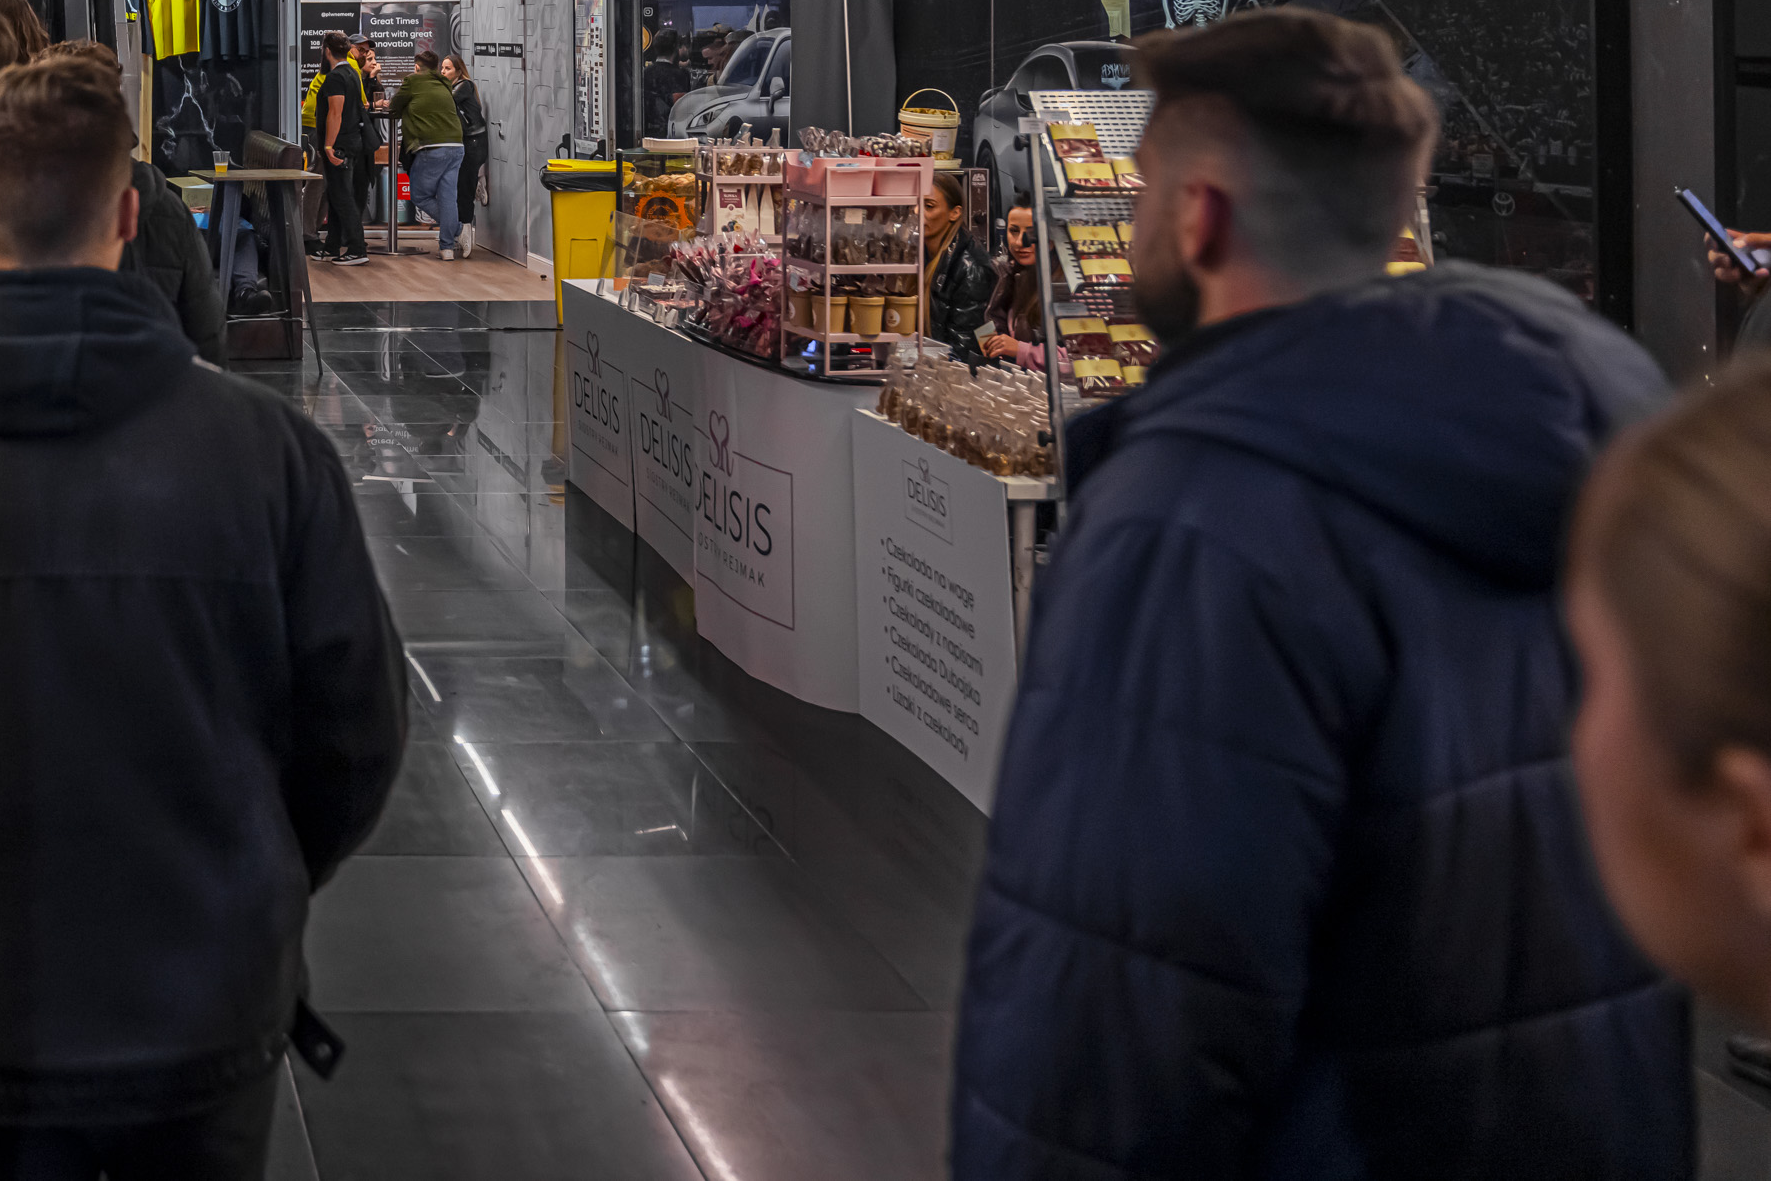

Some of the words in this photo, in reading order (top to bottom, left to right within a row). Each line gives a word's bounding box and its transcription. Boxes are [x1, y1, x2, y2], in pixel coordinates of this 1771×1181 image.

[370, 17, 394, 25] Great
[395, 17, 420, 25] Times
[374, 40, 414, 48] nnovation
[392, 30, 409, 38] with
[410, 30, 433, 40] great
[573, 370, 621, 435] DELISIS
[640, 411, 694, 488] DELISIS
[906, 477, 947, 518] DELISIS
[722, 554, 766, 588] REJMAK
[886, 537, 933, 580] Czekolada
[934, 570, 946, 590] na
[948, 577, 975, 612] wagę
[887, 565, 915, 599] Figurki
[915, 587, 976, 640] czekoladowe
[888, 596, 936, 645] Czekolady
[942, 635, 984, 678] napisami
[890, 625, 938, 675] Czekolada
[938, 658, 981, 707] Dubajska
[891, 655, 952, 715] Czekoladowe
[953, 703, 979, 736] serca
[892, 684, 916, 716] Lizaki
[923, 711, 969, 762] czekolady
